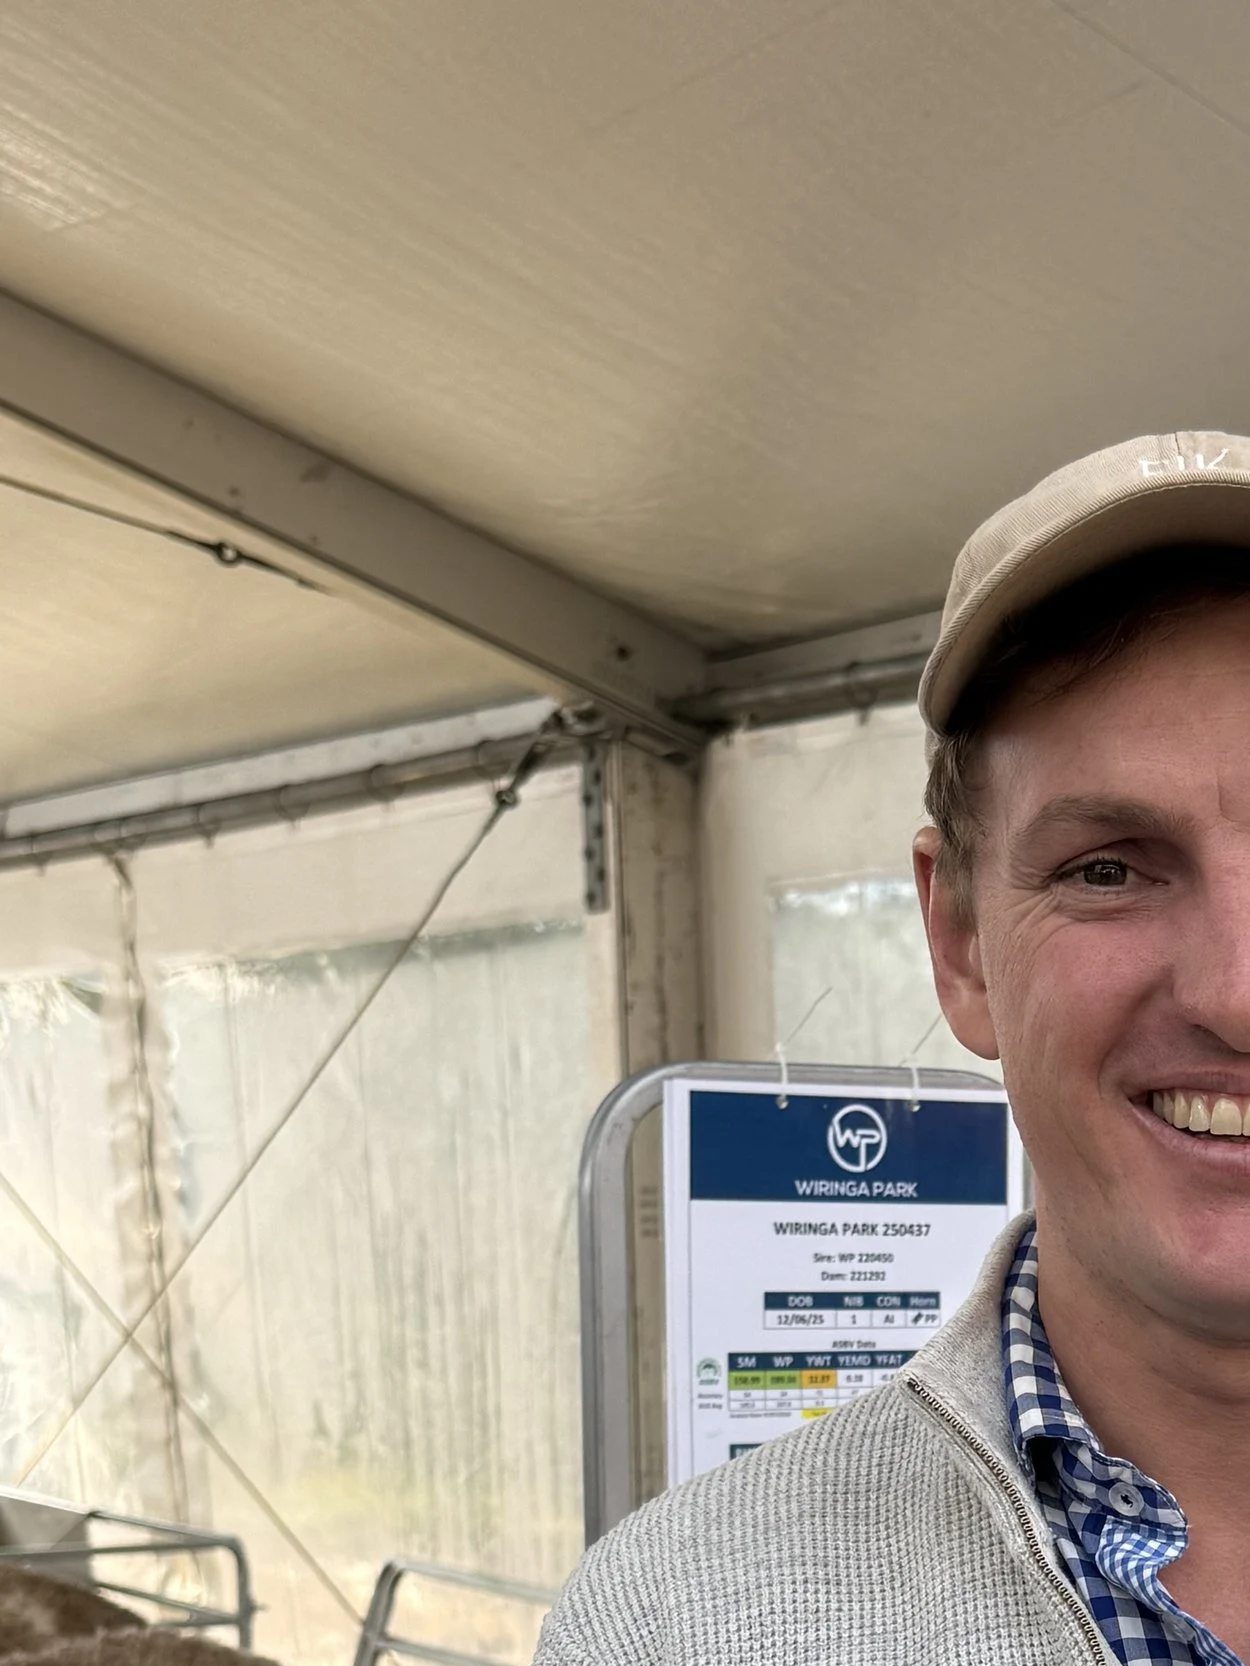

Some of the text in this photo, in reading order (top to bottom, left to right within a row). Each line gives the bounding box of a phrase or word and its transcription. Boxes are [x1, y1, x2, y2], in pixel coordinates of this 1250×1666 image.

[794, 1180, 918, 1198] WIRINGA PARK
[773, 1221, 931, 1237] WIRINGA PARK 250437
[813, 1252, 836, 1264] Sire:
[838, 1252, 855, 1263] WP
[820, 1271, 847, 1281] Dam:
[787, 1296, 814, 1307] DOB
[776, 1313, 825, 1326] 12/06/25
[851, 1314, 857, 1324] 1
[772, 1356, 794, 1368] WP
